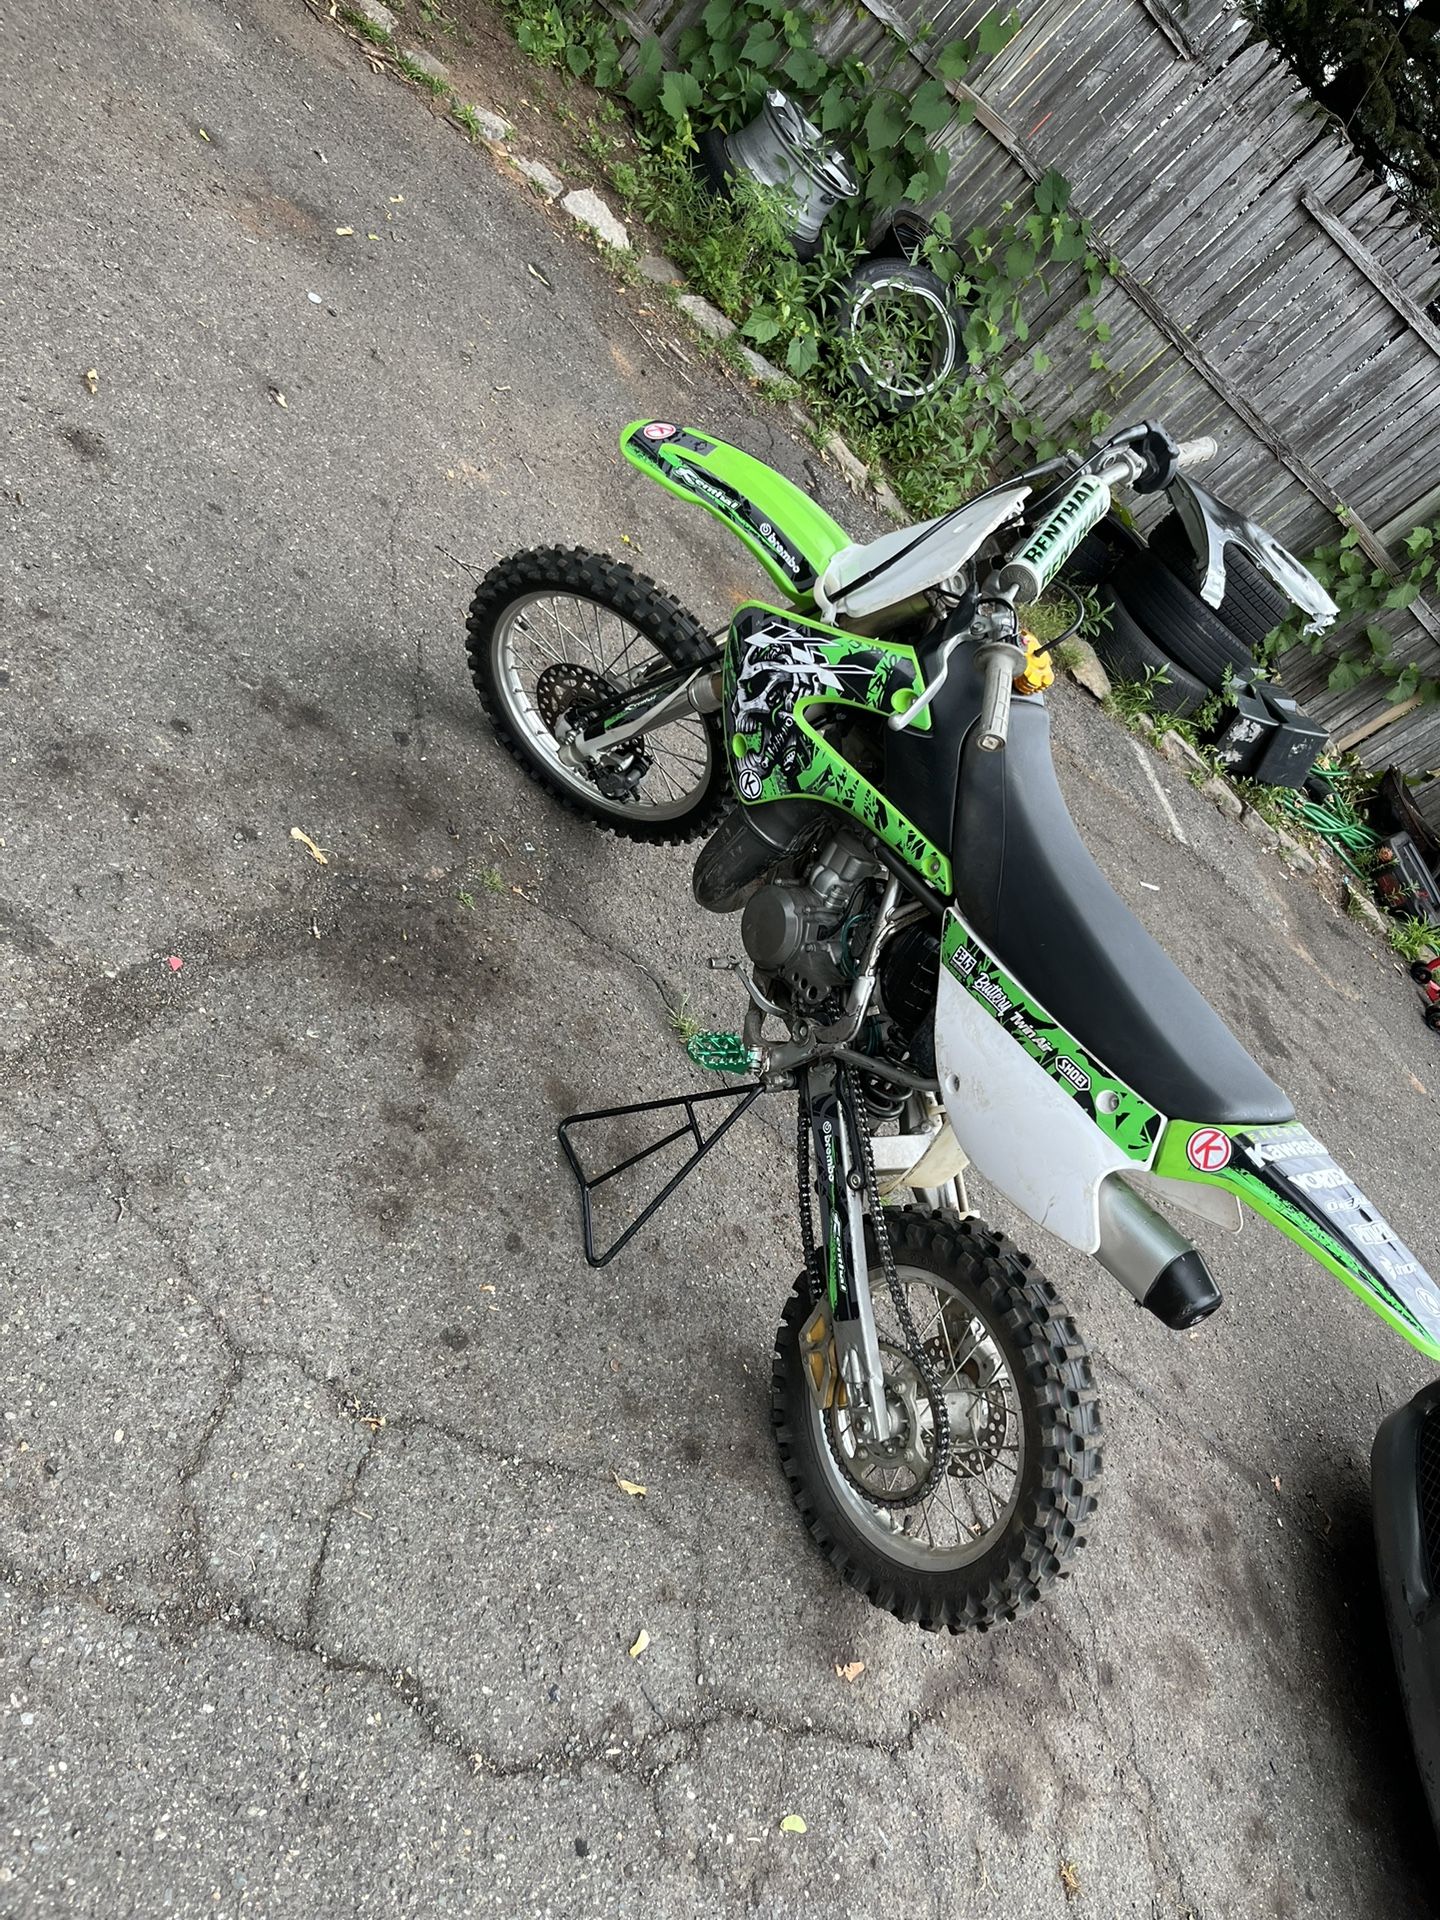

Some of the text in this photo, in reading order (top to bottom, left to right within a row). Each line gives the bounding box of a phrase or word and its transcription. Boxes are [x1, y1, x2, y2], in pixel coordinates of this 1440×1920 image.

[1022, 481, 1101, 564] RENTHAL
[769, 531, 800, 574] brembo
[972, 971, 1013, 1017] Buttery
[1010, 1010, 1053, 1052] Twin Air
[1057, 1058, 1088, 1089] SHOEI
[823, 1134, 835, 1182] brembo
